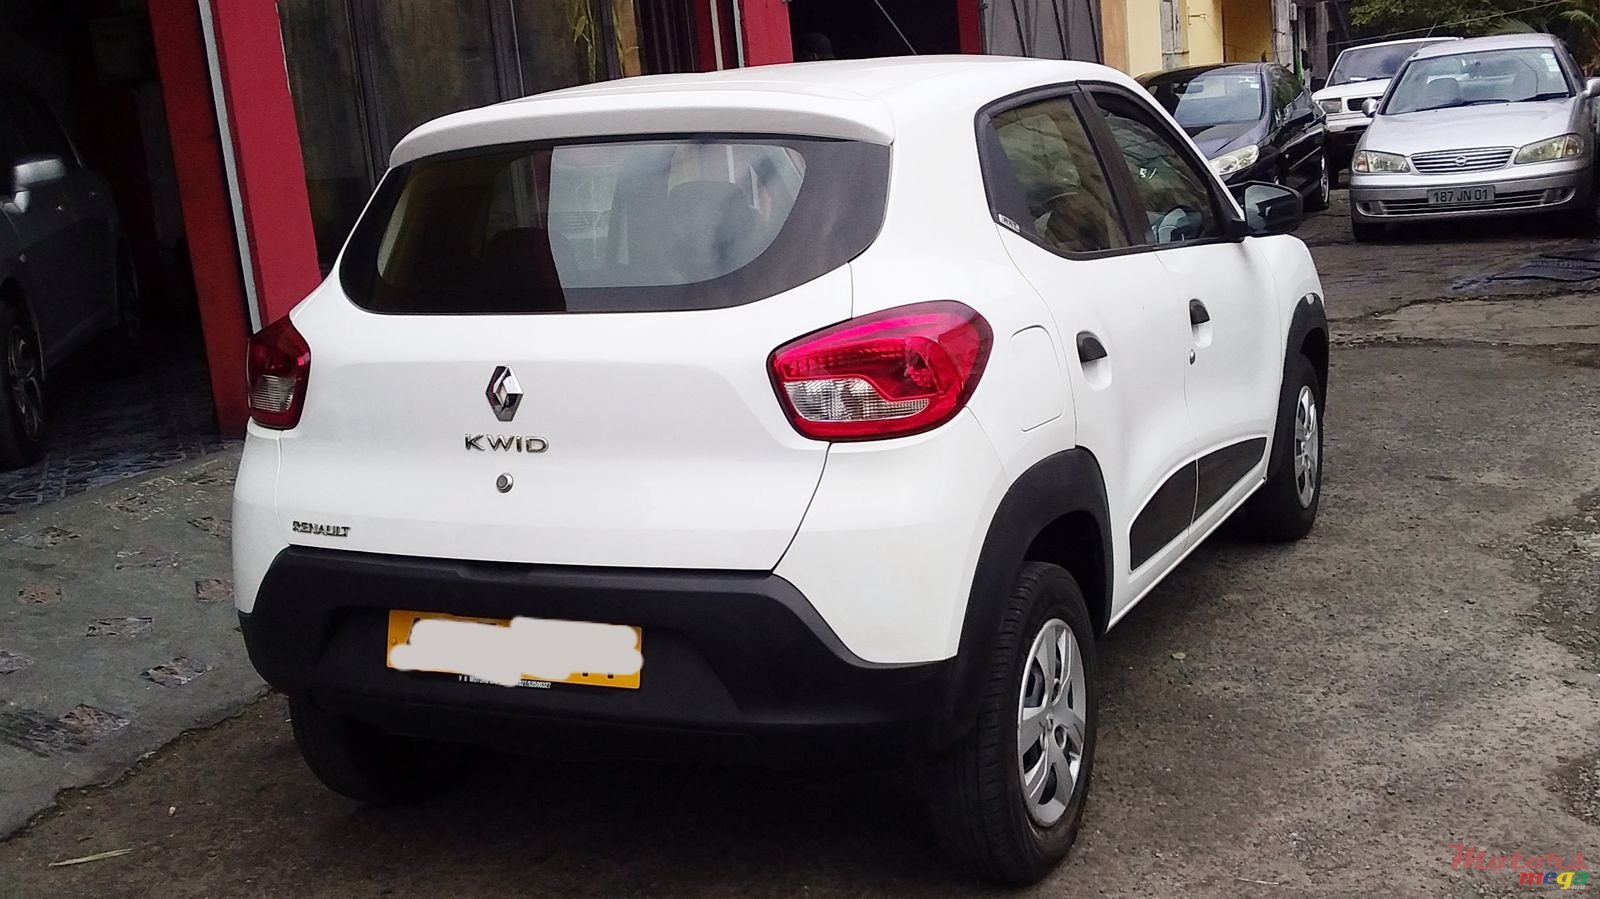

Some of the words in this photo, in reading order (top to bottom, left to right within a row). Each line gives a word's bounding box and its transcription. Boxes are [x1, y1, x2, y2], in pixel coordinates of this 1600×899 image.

[1433, 191, 1453, 203] 187
[1457, 190, 1471, 202] JN
[1475, 189, 1488, 200] 01
[465, 433, 549, 453] KWID
[292, 520, 351, 537] RENAULT
